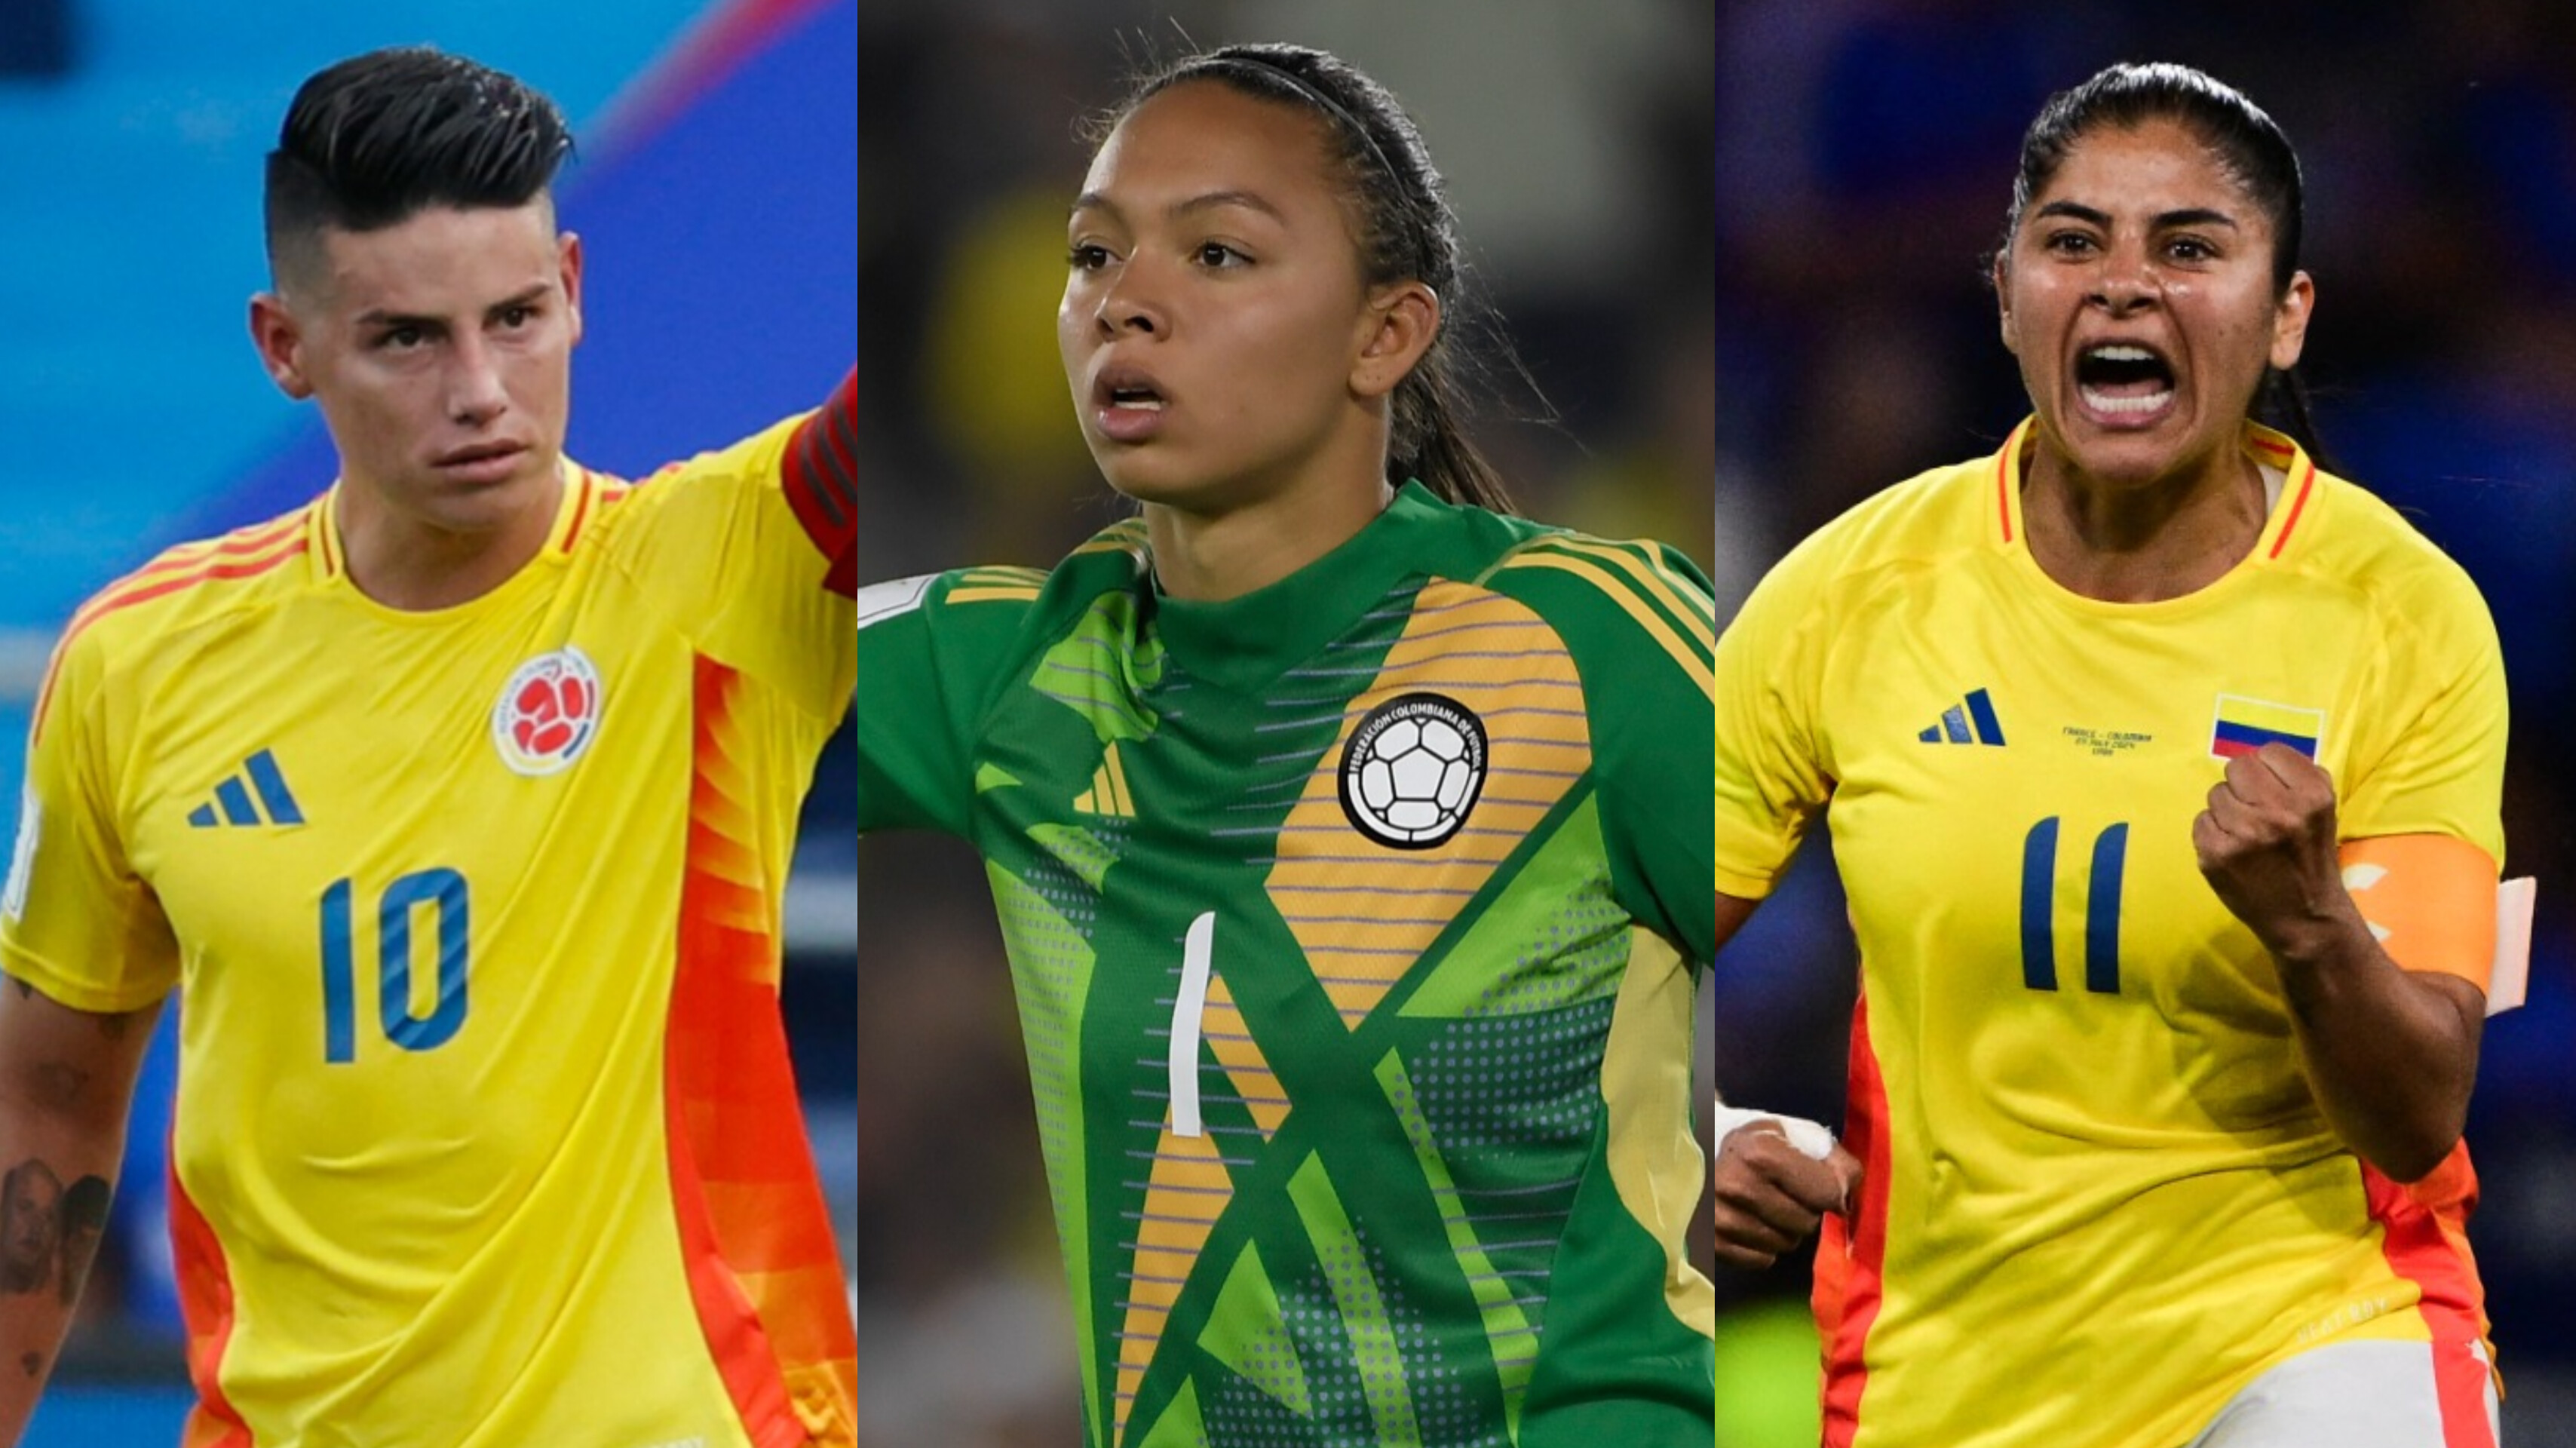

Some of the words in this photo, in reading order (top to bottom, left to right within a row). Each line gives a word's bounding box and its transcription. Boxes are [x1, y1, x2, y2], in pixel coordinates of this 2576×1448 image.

[1391, 703, 1459, 726] COLOMBIANA
[1458, 720, 1471, 735] DE
[2107, 731, 2152, 742] COLOMBIA
[320, 867, 469, 1063] 10
[2020, 815, 2129, 995] 11
[1170, 911, 1216, 1137] 1
